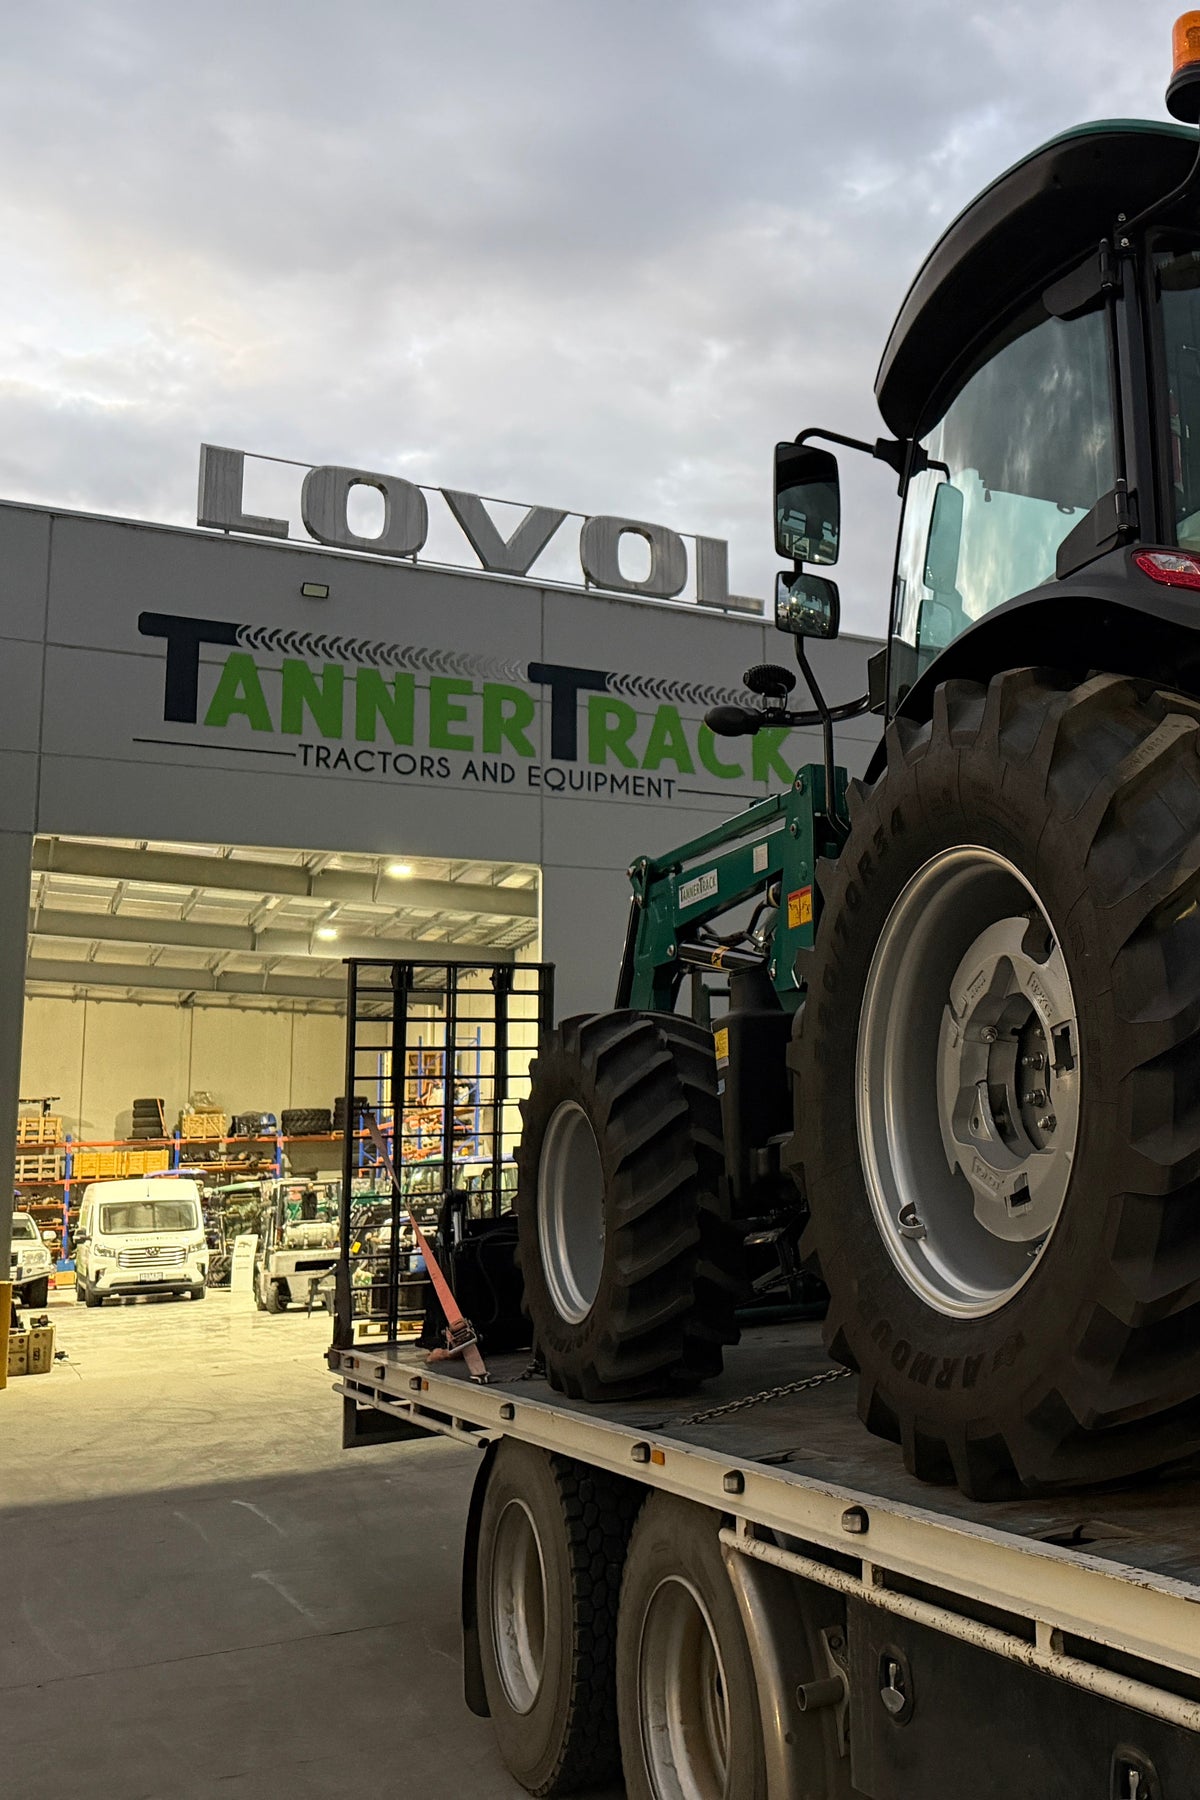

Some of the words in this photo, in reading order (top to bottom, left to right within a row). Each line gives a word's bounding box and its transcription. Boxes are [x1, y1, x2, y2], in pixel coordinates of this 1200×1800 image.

[197, 443, 764, 616] LOVOL
[299, 744, 451, 778] TRACTORS
[462, 760, 515, 784] AND
[528, 766, 676, 799] EQUIPMENT
